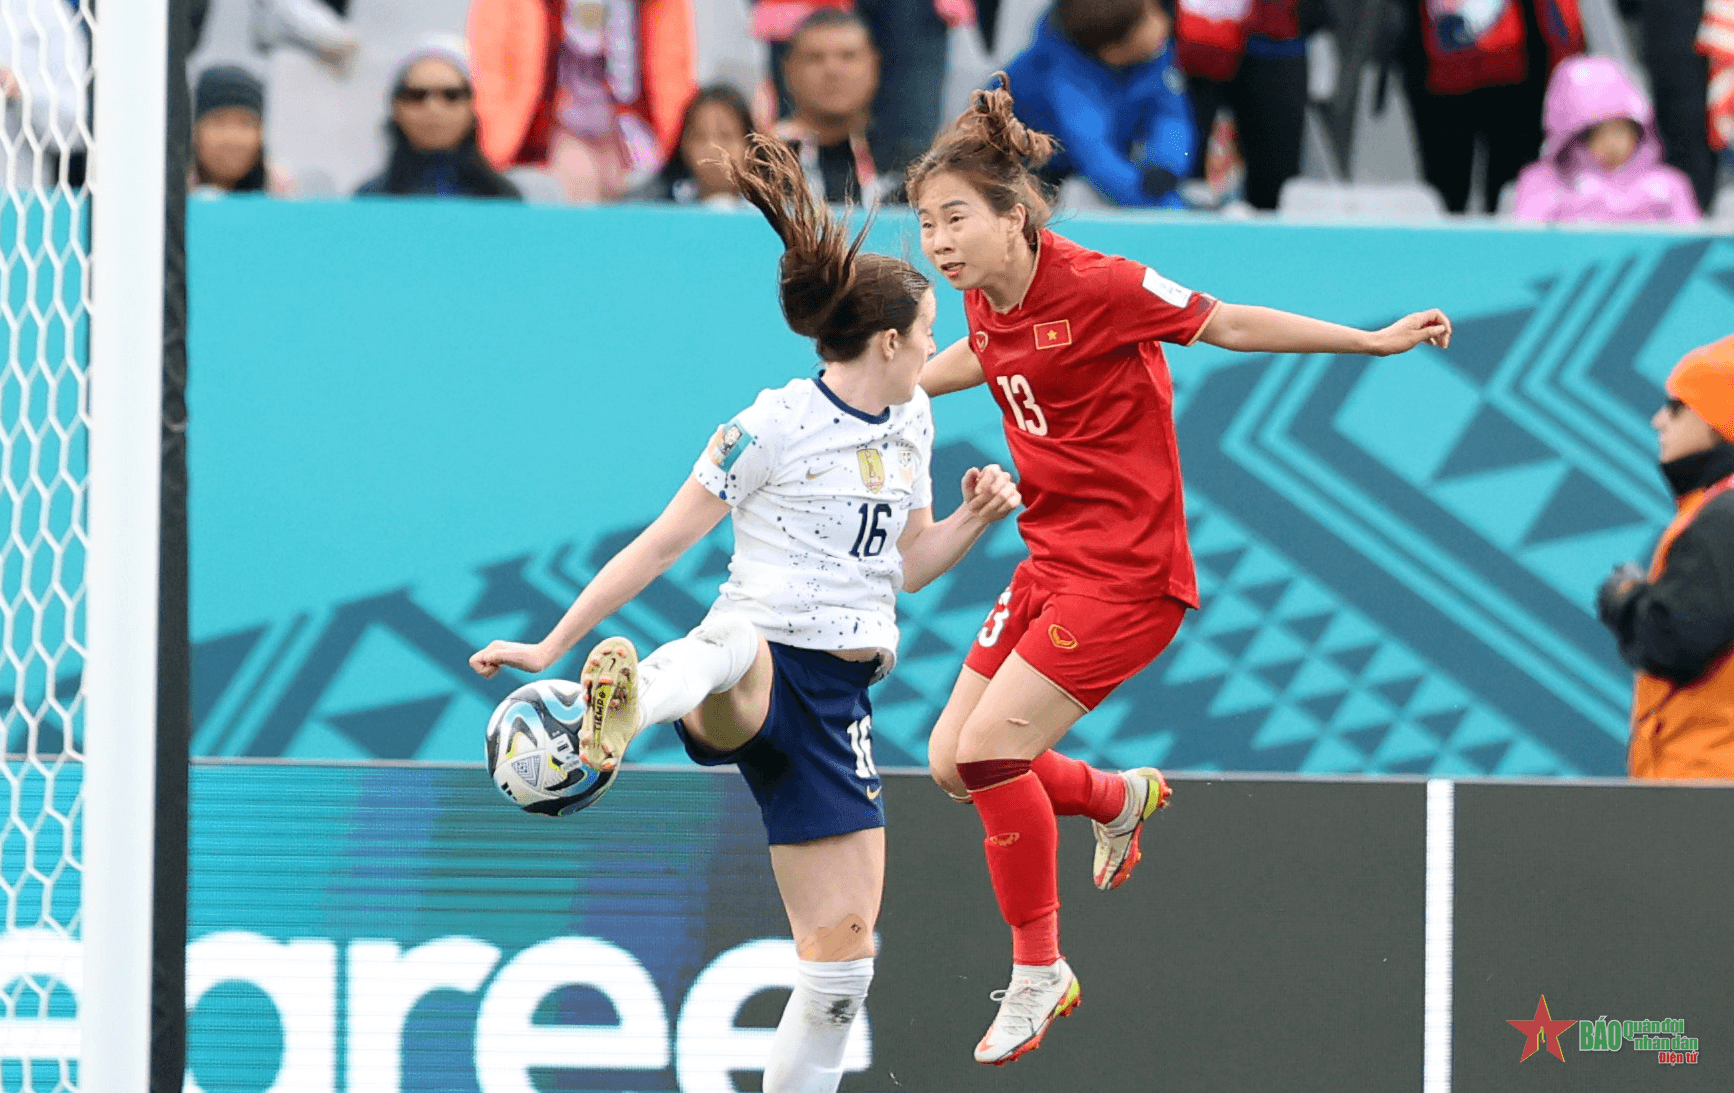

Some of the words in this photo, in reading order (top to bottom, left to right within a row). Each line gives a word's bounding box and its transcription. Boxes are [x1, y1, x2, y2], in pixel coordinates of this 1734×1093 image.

[996, 374, 1048, 437] 13
[849, 503, 892, 557] 16
[977, 586, 1012, 648] 3
